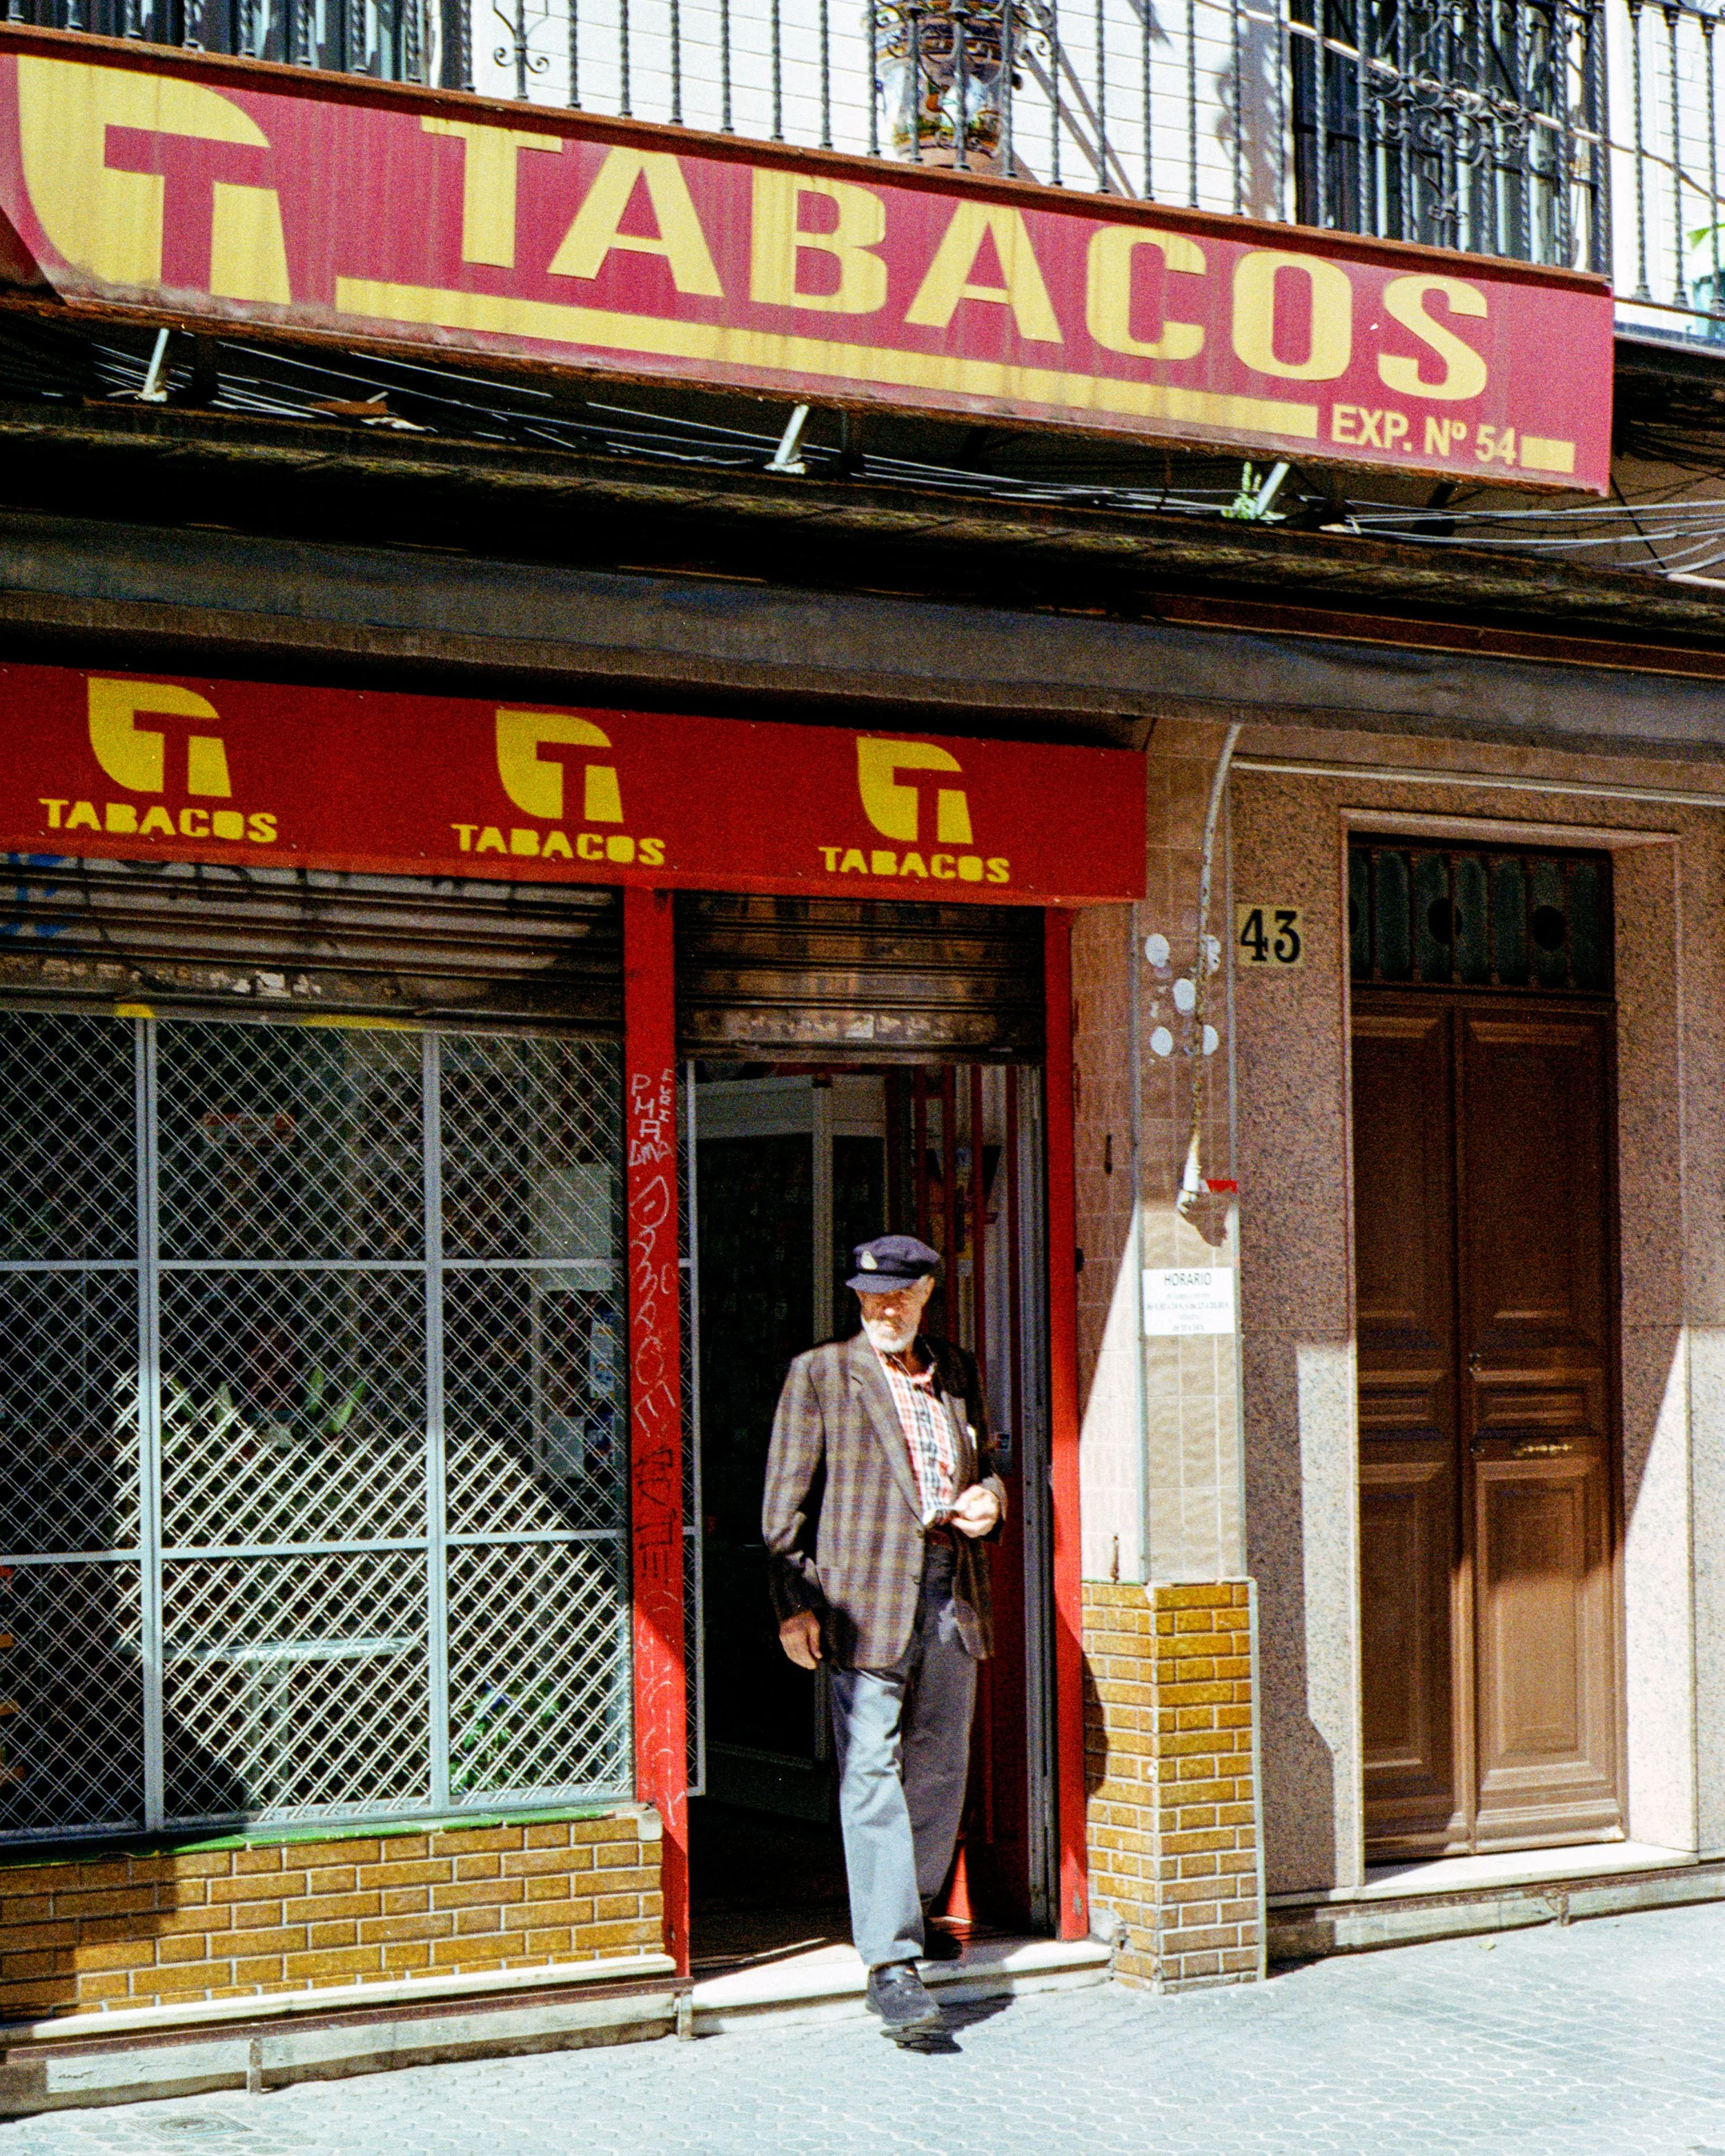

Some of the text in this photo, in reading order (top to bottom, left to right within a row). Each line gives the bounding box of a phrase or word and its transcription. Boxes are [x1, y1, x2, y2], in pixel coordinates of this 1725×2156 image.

[420, 115, 1488, 401] TABACOS
[1331, 403, 1412, 452] EXP.
[1475, 424, 1517, 465] 54
[38, 798, 277, 842] TABACOS
[450, 823, 666, 866] TABACOS
[818, 846, 1010, 883] TABACOS
[1241, 909, 1301, 963] 43
[1164, 1272, 1212, 1286] HORARIO
